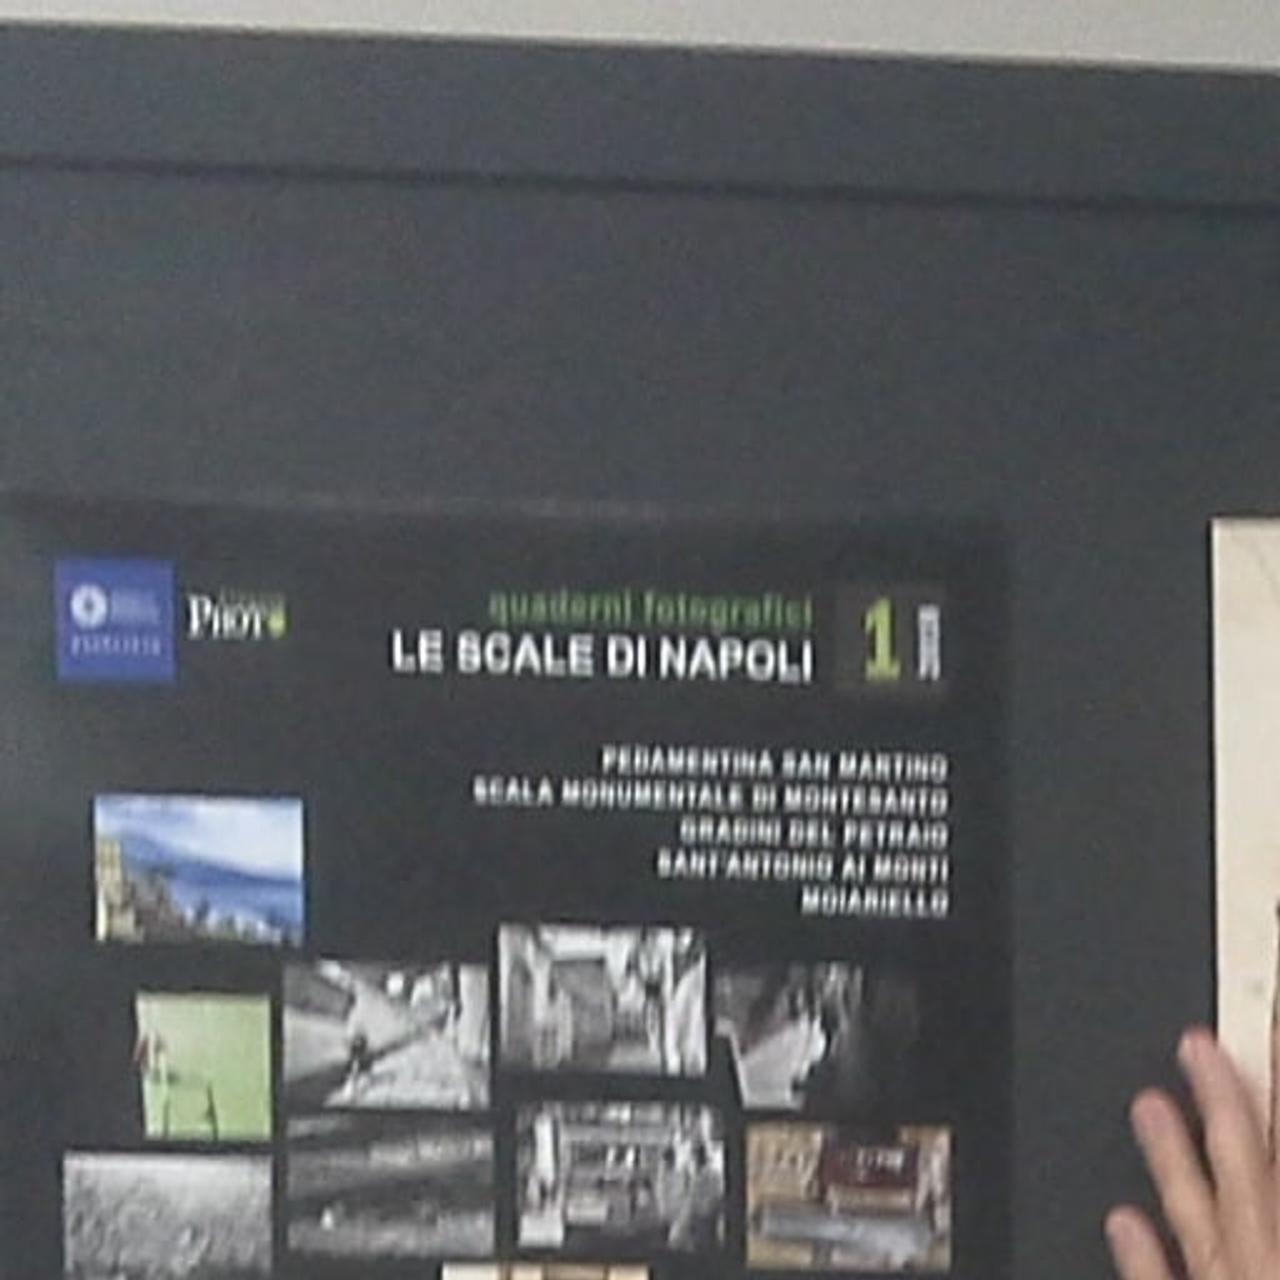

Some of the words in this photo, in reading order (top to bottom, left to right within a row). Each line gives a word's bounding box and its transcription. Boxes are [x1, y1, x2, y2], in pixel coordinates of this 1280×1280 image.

[393, 630, 443, 673] LE
[458, 631, 595, 675] SCALE
[607, 634, 646, 678] DI
[659, 636, 813, 682] NAPOLI
[865, 598, 899, 680] 1
[602, 745, 774, 778] PEDAMENTINA
[782, 748, 830, 779] SAN
[839, 750, 948, 784] MARTINO
[474, 774, 553, 806] SCALA
[561, 777, 742, 809] MONUMENTALE
[752, 782, 777, 811] DI
[784, 783, 948, 815] MONTESANTO
[680, 814, 782, 846] GRADINI
[790, 817, 835, 848] DEL
[841, 851, 865, 881] AI
[873, 853, 948, 882] MONTI
